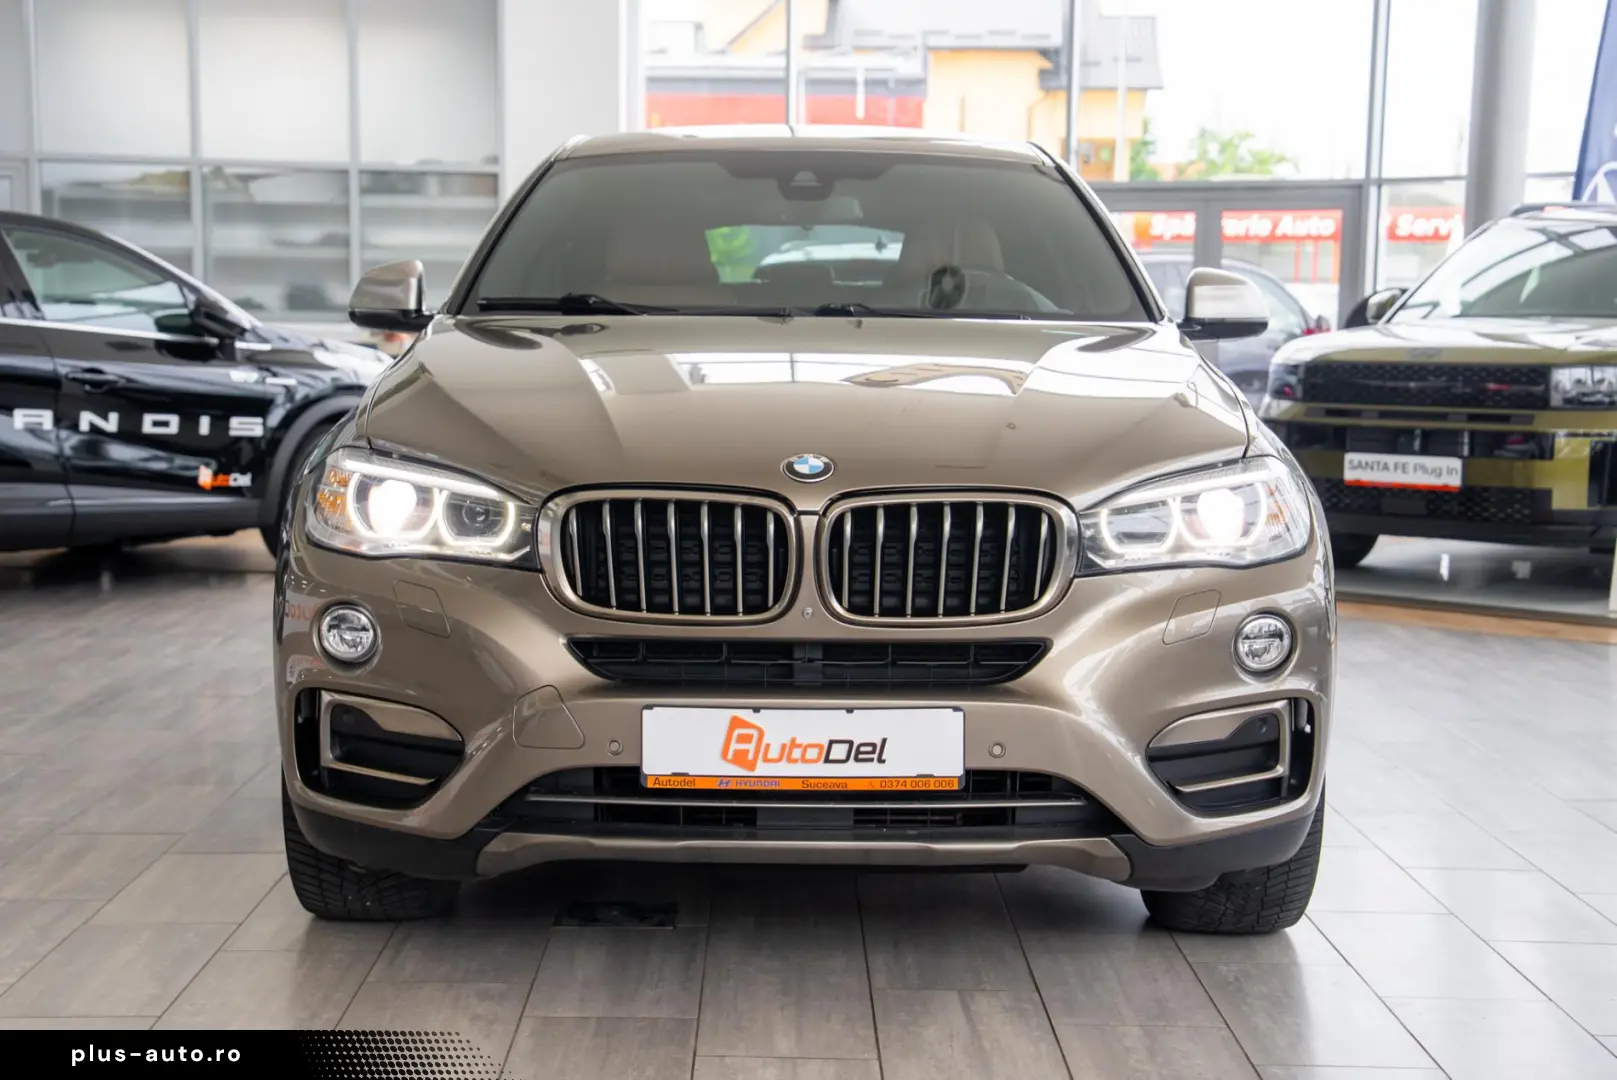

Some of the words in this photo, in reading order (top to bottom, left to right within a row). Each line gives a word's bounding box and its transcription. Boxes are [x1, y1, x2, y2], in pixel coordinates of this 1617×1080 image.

[1276, 214, 1336, 236] Auto
[13, 408, 264, 437] ANDIS
[1347, 458, 1390, 473] SANTA
[1393, 461, 1410, 475] FE
[1413, 462, 1443, 478] Plug
[1446, 465, 1459, 476] In
[722, 720, 888, 768] AutoDel
[653, 777, 696, 788] Autodel
[735, 779, 781, 788] HYUNDAI
[801, 779, 848, 789] Suceava
[879, 780, 908, 789] 0374
[910, 780, 931, 789] 006
[933, 780, 955, 789] 006
